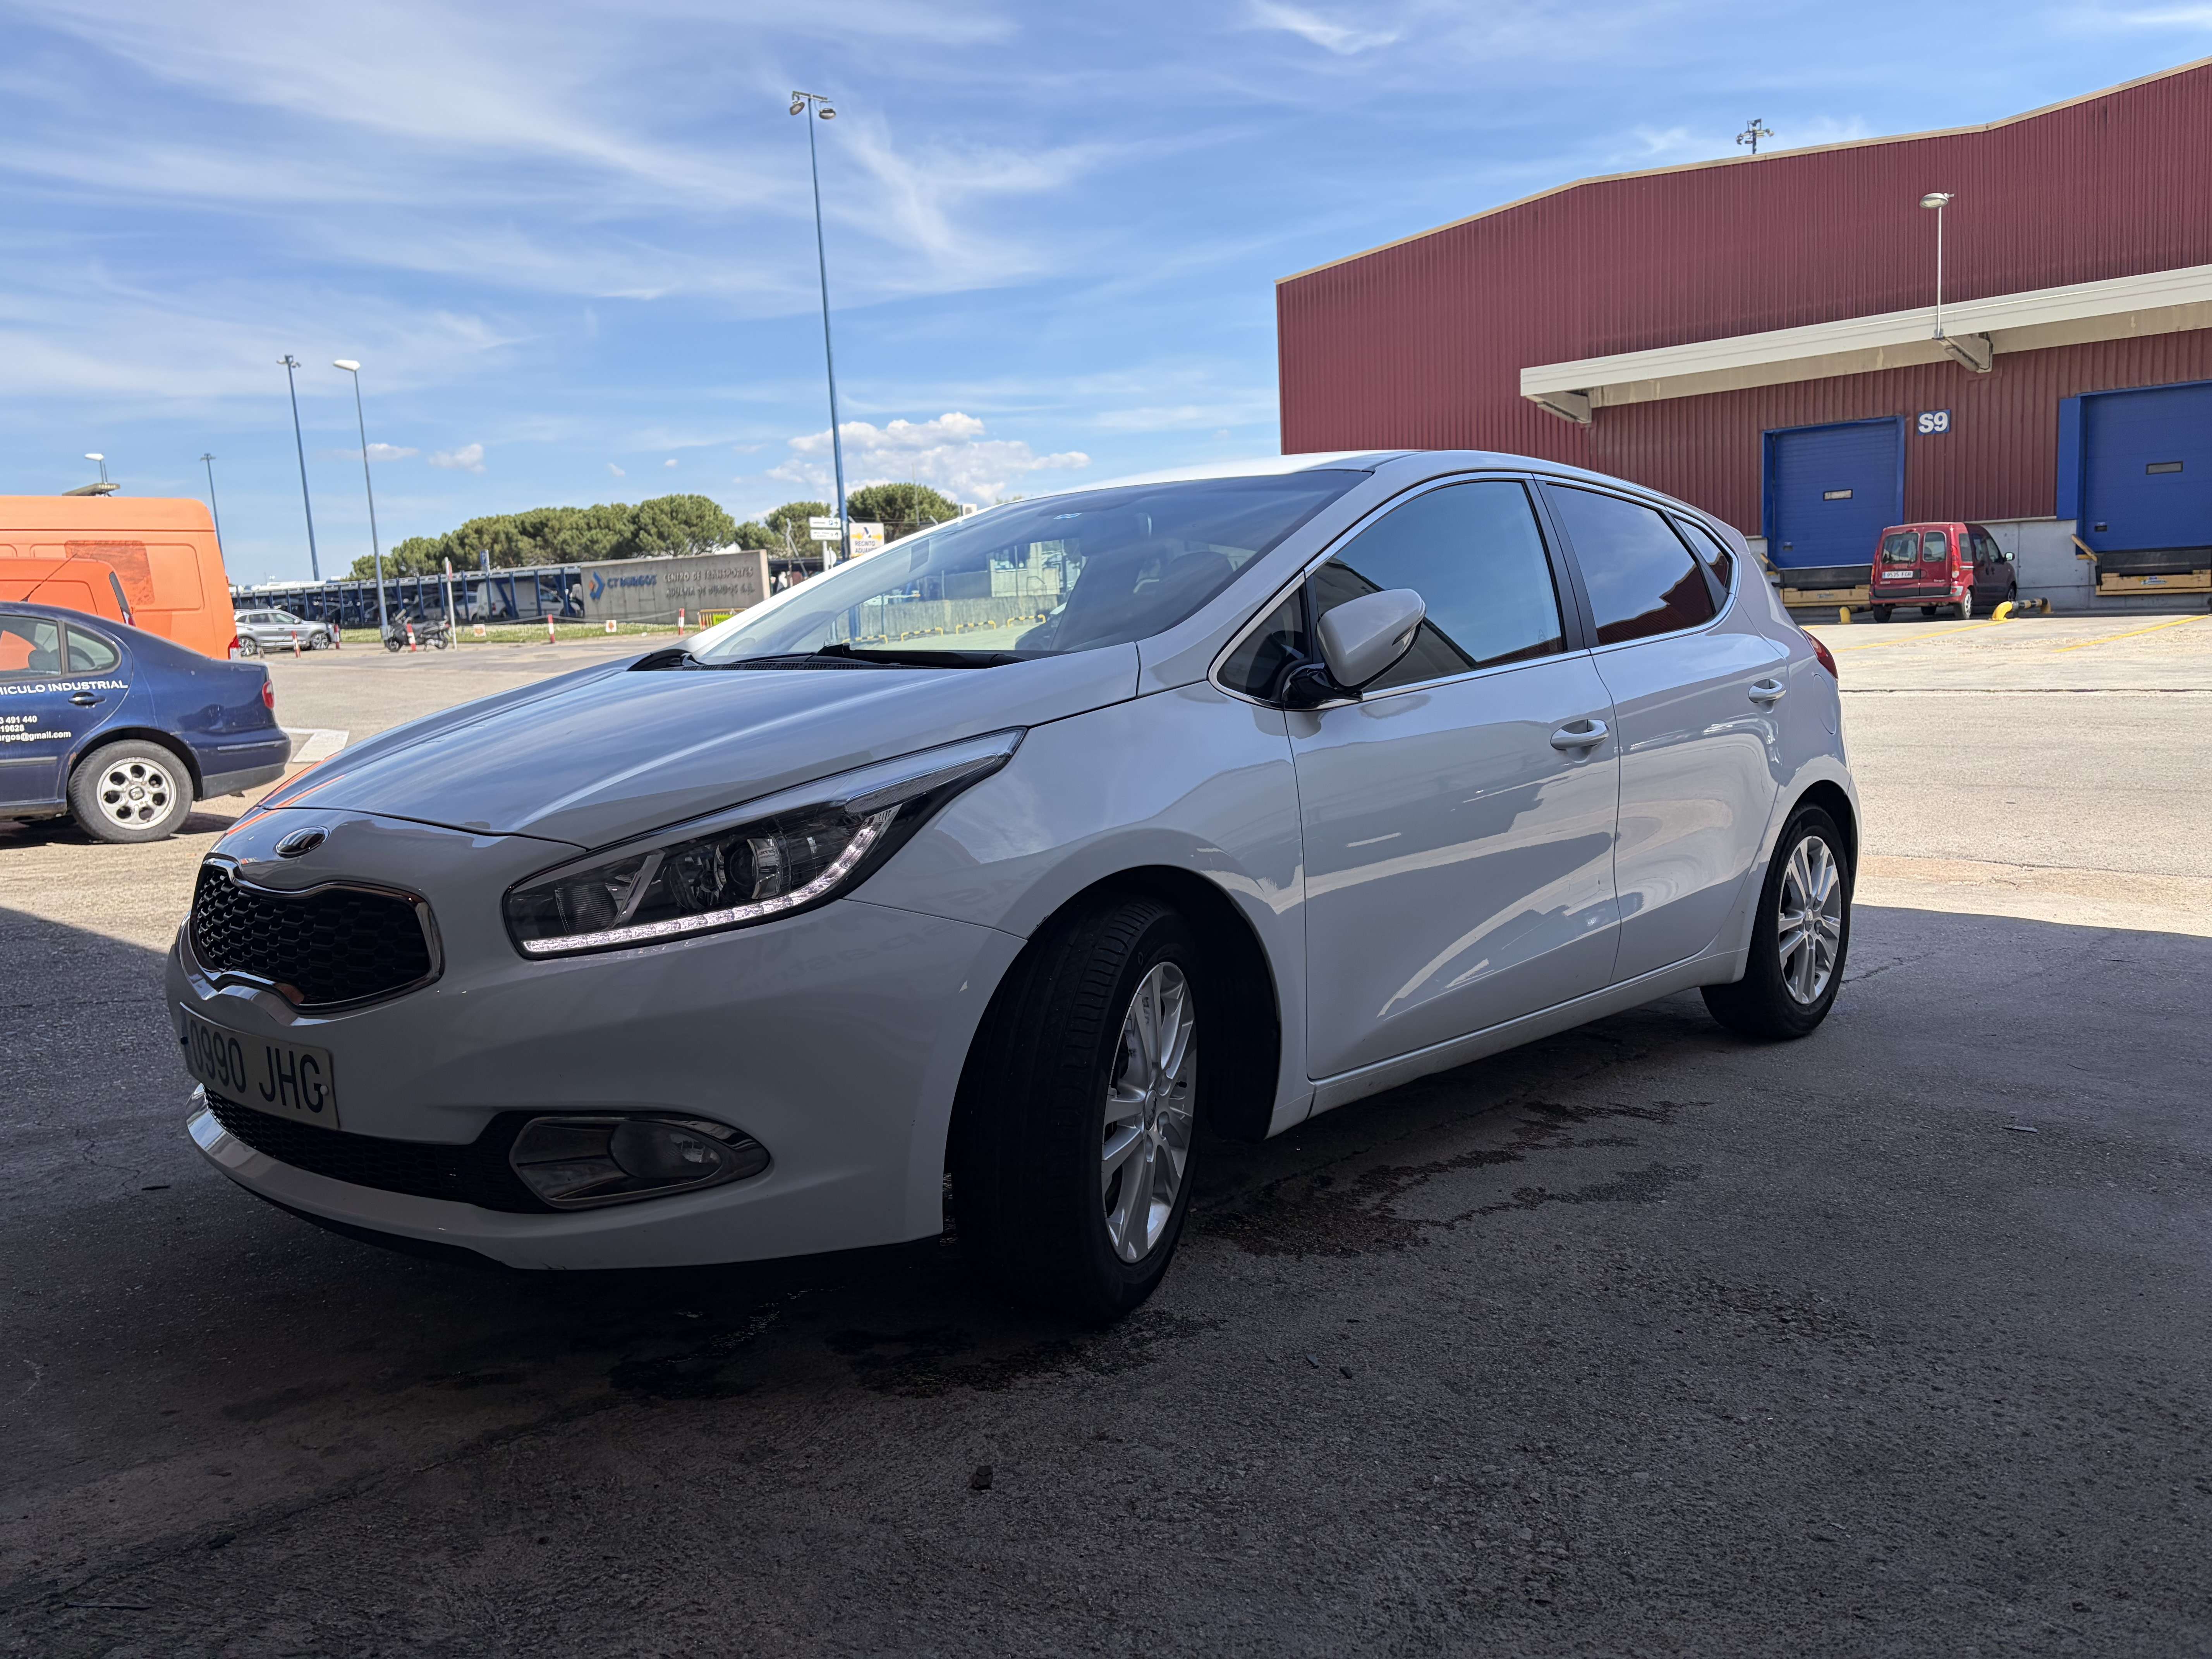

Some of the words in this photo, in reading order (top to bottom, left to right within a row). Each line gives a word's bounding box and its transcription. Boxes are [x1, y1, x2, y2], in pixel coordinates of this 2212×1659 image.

[1918, 412, 1948, 433] S9
[607, 578, 619, 589] CT
[620, 574, 657, 587] BURGOS
[664, 572, 690, 582] CENTRO
[692, 570, 701, 581] DE
[705, 567, 753, 580] TRANSPORTES
[48, 680, 128, 692] INDUSTRIAL
[191, 1020, 246, 1093] 0990
[259, 1046, 324, 1113] JHG
